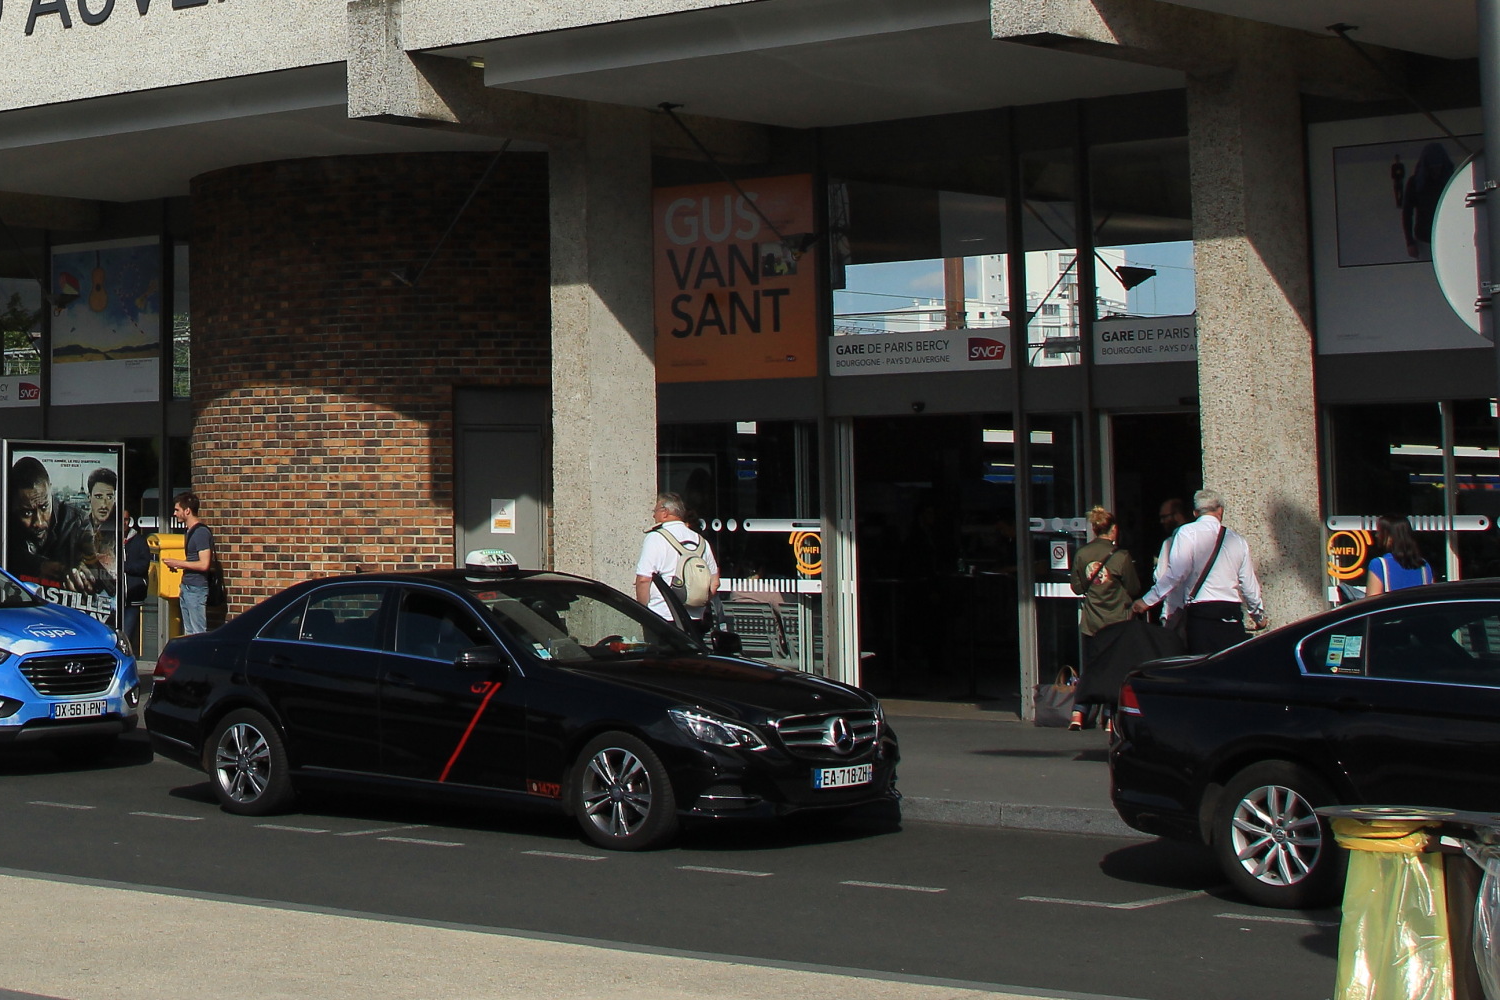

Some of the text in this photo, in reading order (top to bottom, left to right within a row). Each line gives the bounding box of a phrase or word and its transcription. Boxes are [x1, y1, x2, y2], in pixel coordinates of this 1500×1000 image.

[665, 191, 761, 246] GUS
[666, 242, 761, 291] VAN
[671, 288, 790, 339] SANT
[1102, 330, 1135, 343] GARE
[1137, 329, 1154, 341] DE
[1157, 327, 1190, 340] PARIS
[835, 339, 950, 356] GARE DE PARIS BERCY
[970, 345, 1002, 359] SNCF
[1102, 344, 1153, 356] BOURGOGNE
[1159, 344, 1177, 354] PAYS
[835, 356, 881, 368] BOURGOGNE
[886, 356, 902, 366] PAYS
[903, 354, 950, 365] D'AUVERGNE
[20, 387, 39, 398] SNCF
[801, 546, 820, 554] WIFI
[1332, 547, 1354, 555] WIFI
[488, 554, 513, 562] TAXI
[28, 628, 76, 638] hype
[471, 681, 492, 694] G7
[55, 701, 101, 717] DX-561-PN
[823, 766, 868, 786] EA-718-ZH
